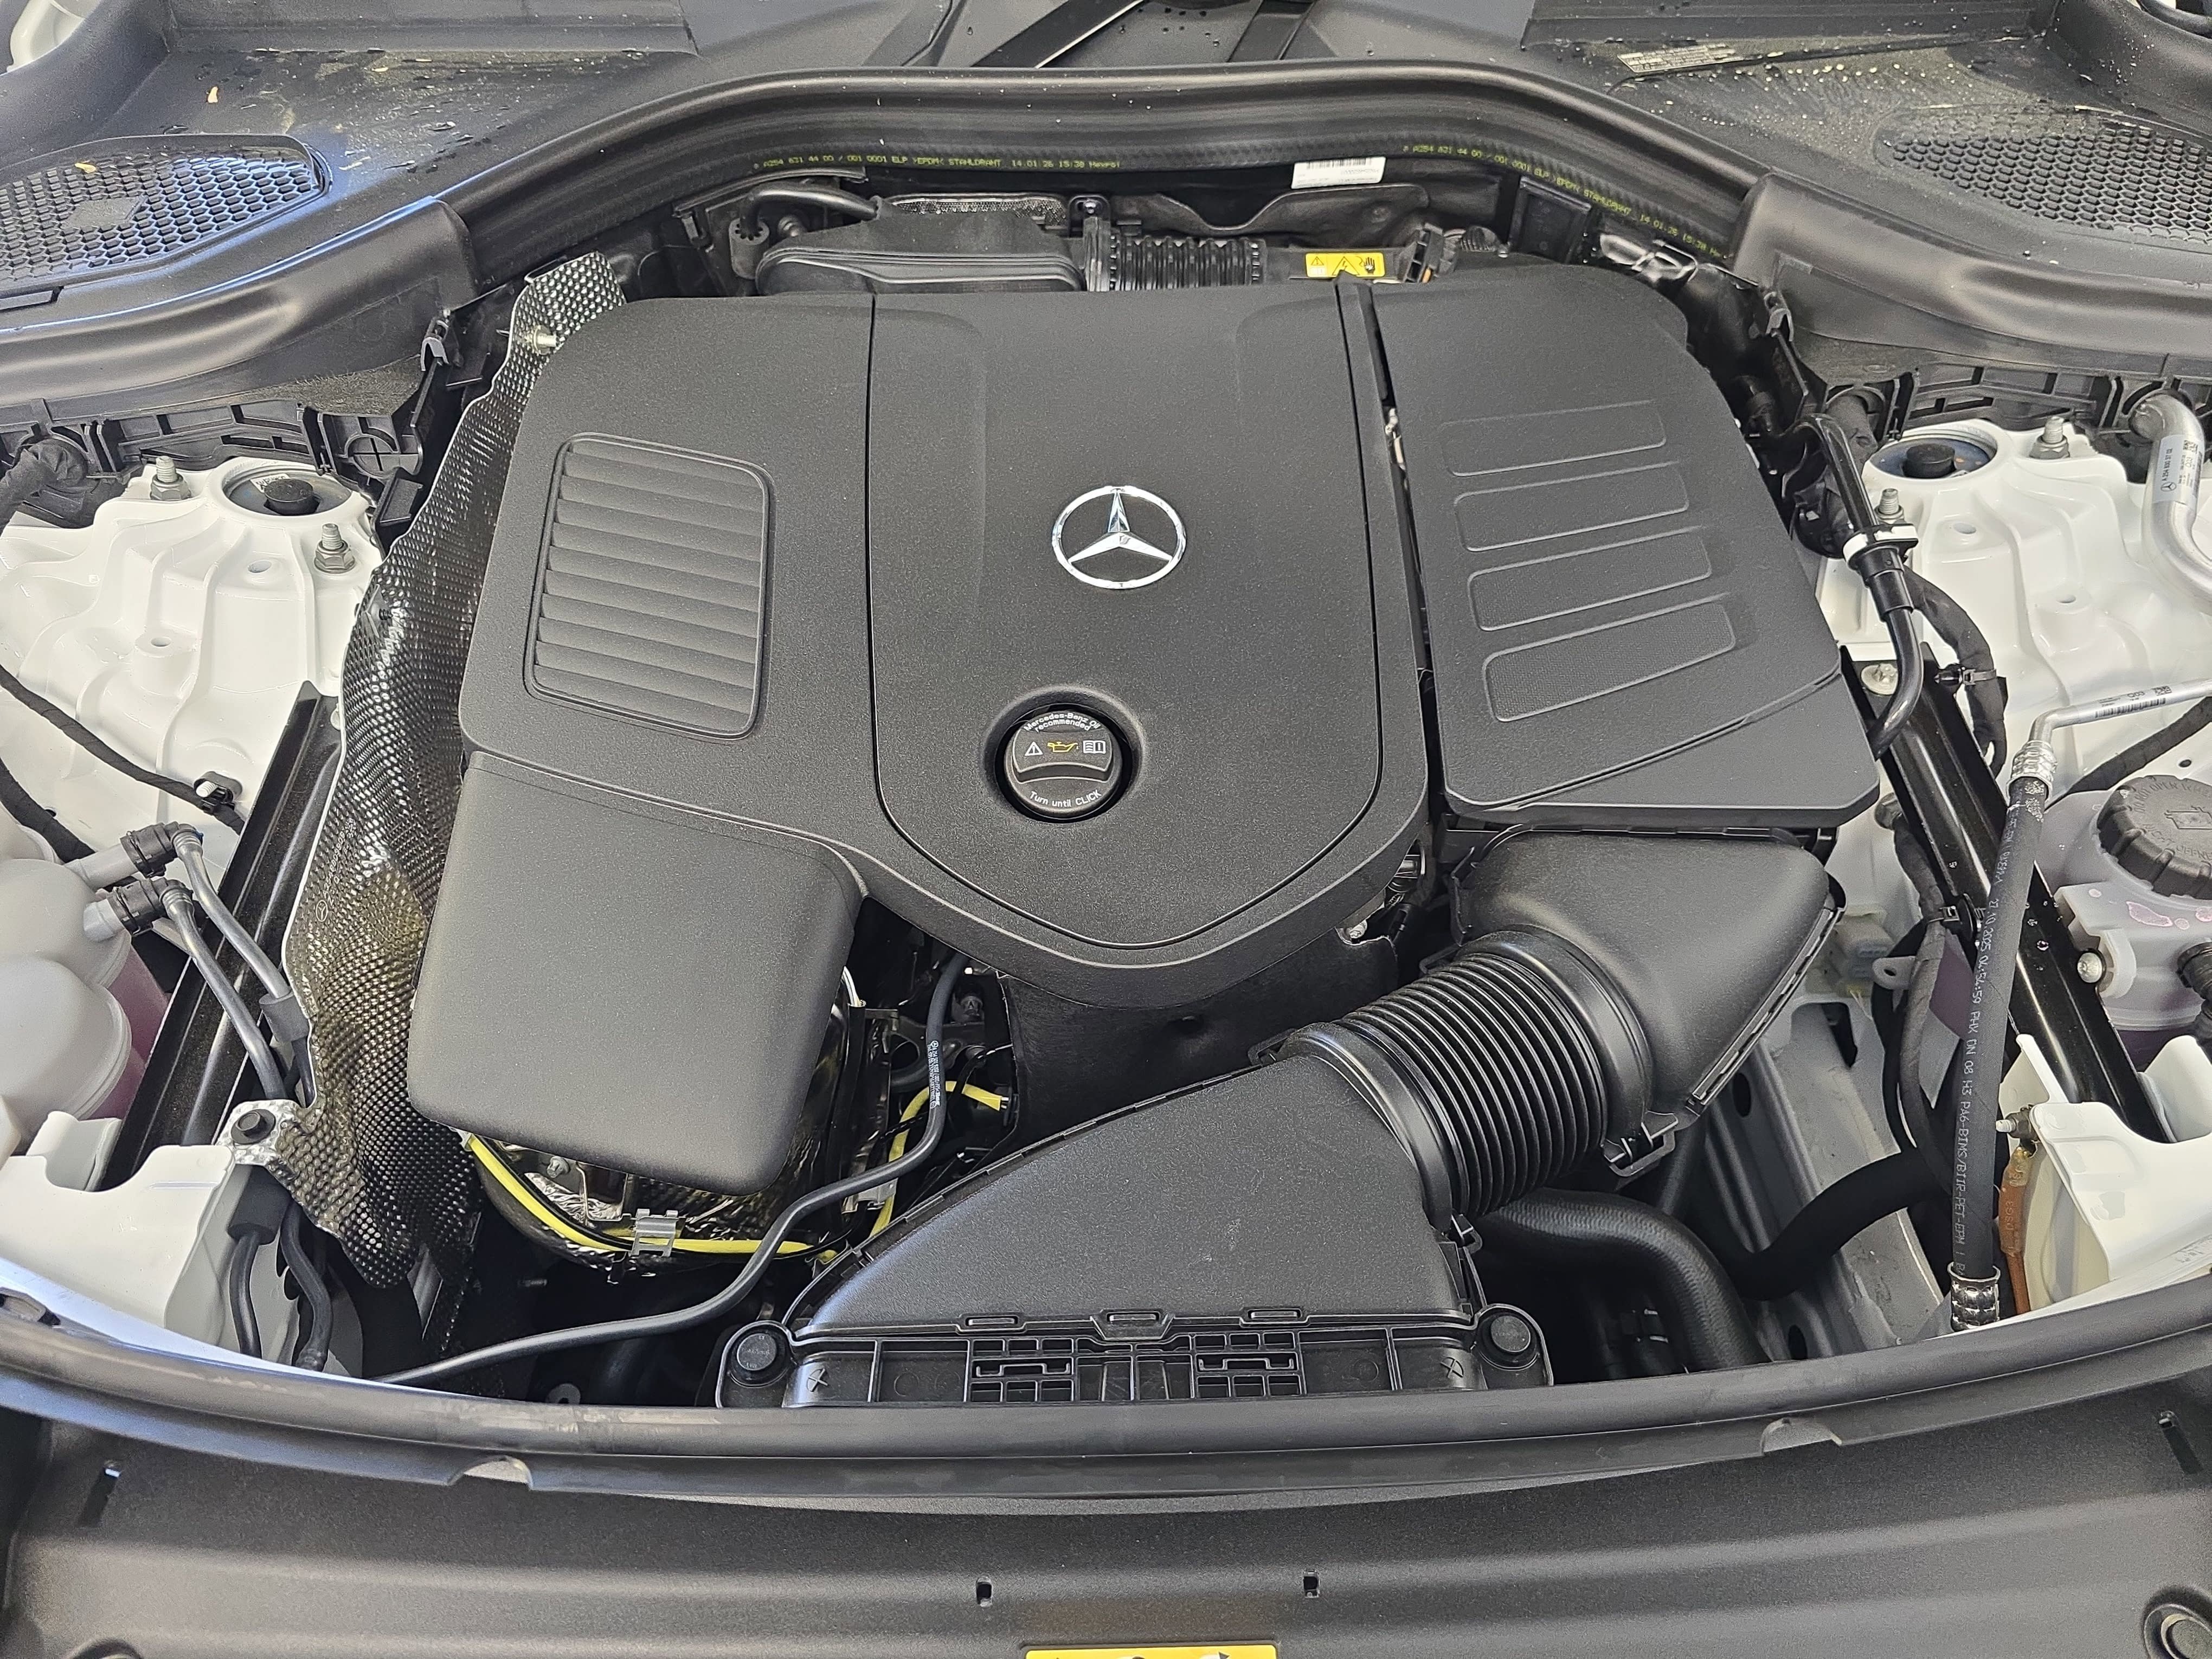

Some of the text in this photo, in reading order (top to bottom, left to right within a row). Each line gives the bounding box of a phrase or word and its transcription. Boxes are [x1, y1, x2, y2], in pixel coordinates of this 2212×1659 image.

[1023, 712, 1102, 732] Mercedes-Benz Oil
[1034, 718, 1093, 733] recommended
[1030, 789, 1102, 808] Turn until CLICK
[1980, 898, 1999, 952] 27.10.2025
[1972, 955, 1989, 1004] 04:54:59
[1968, 1011, 1980, 1034] PHX
[1966, 1039, 1977, 1055] DN
[1964, 1060, 1974, 1075] 08
[1962, 1080, 1972, 1096] H3
